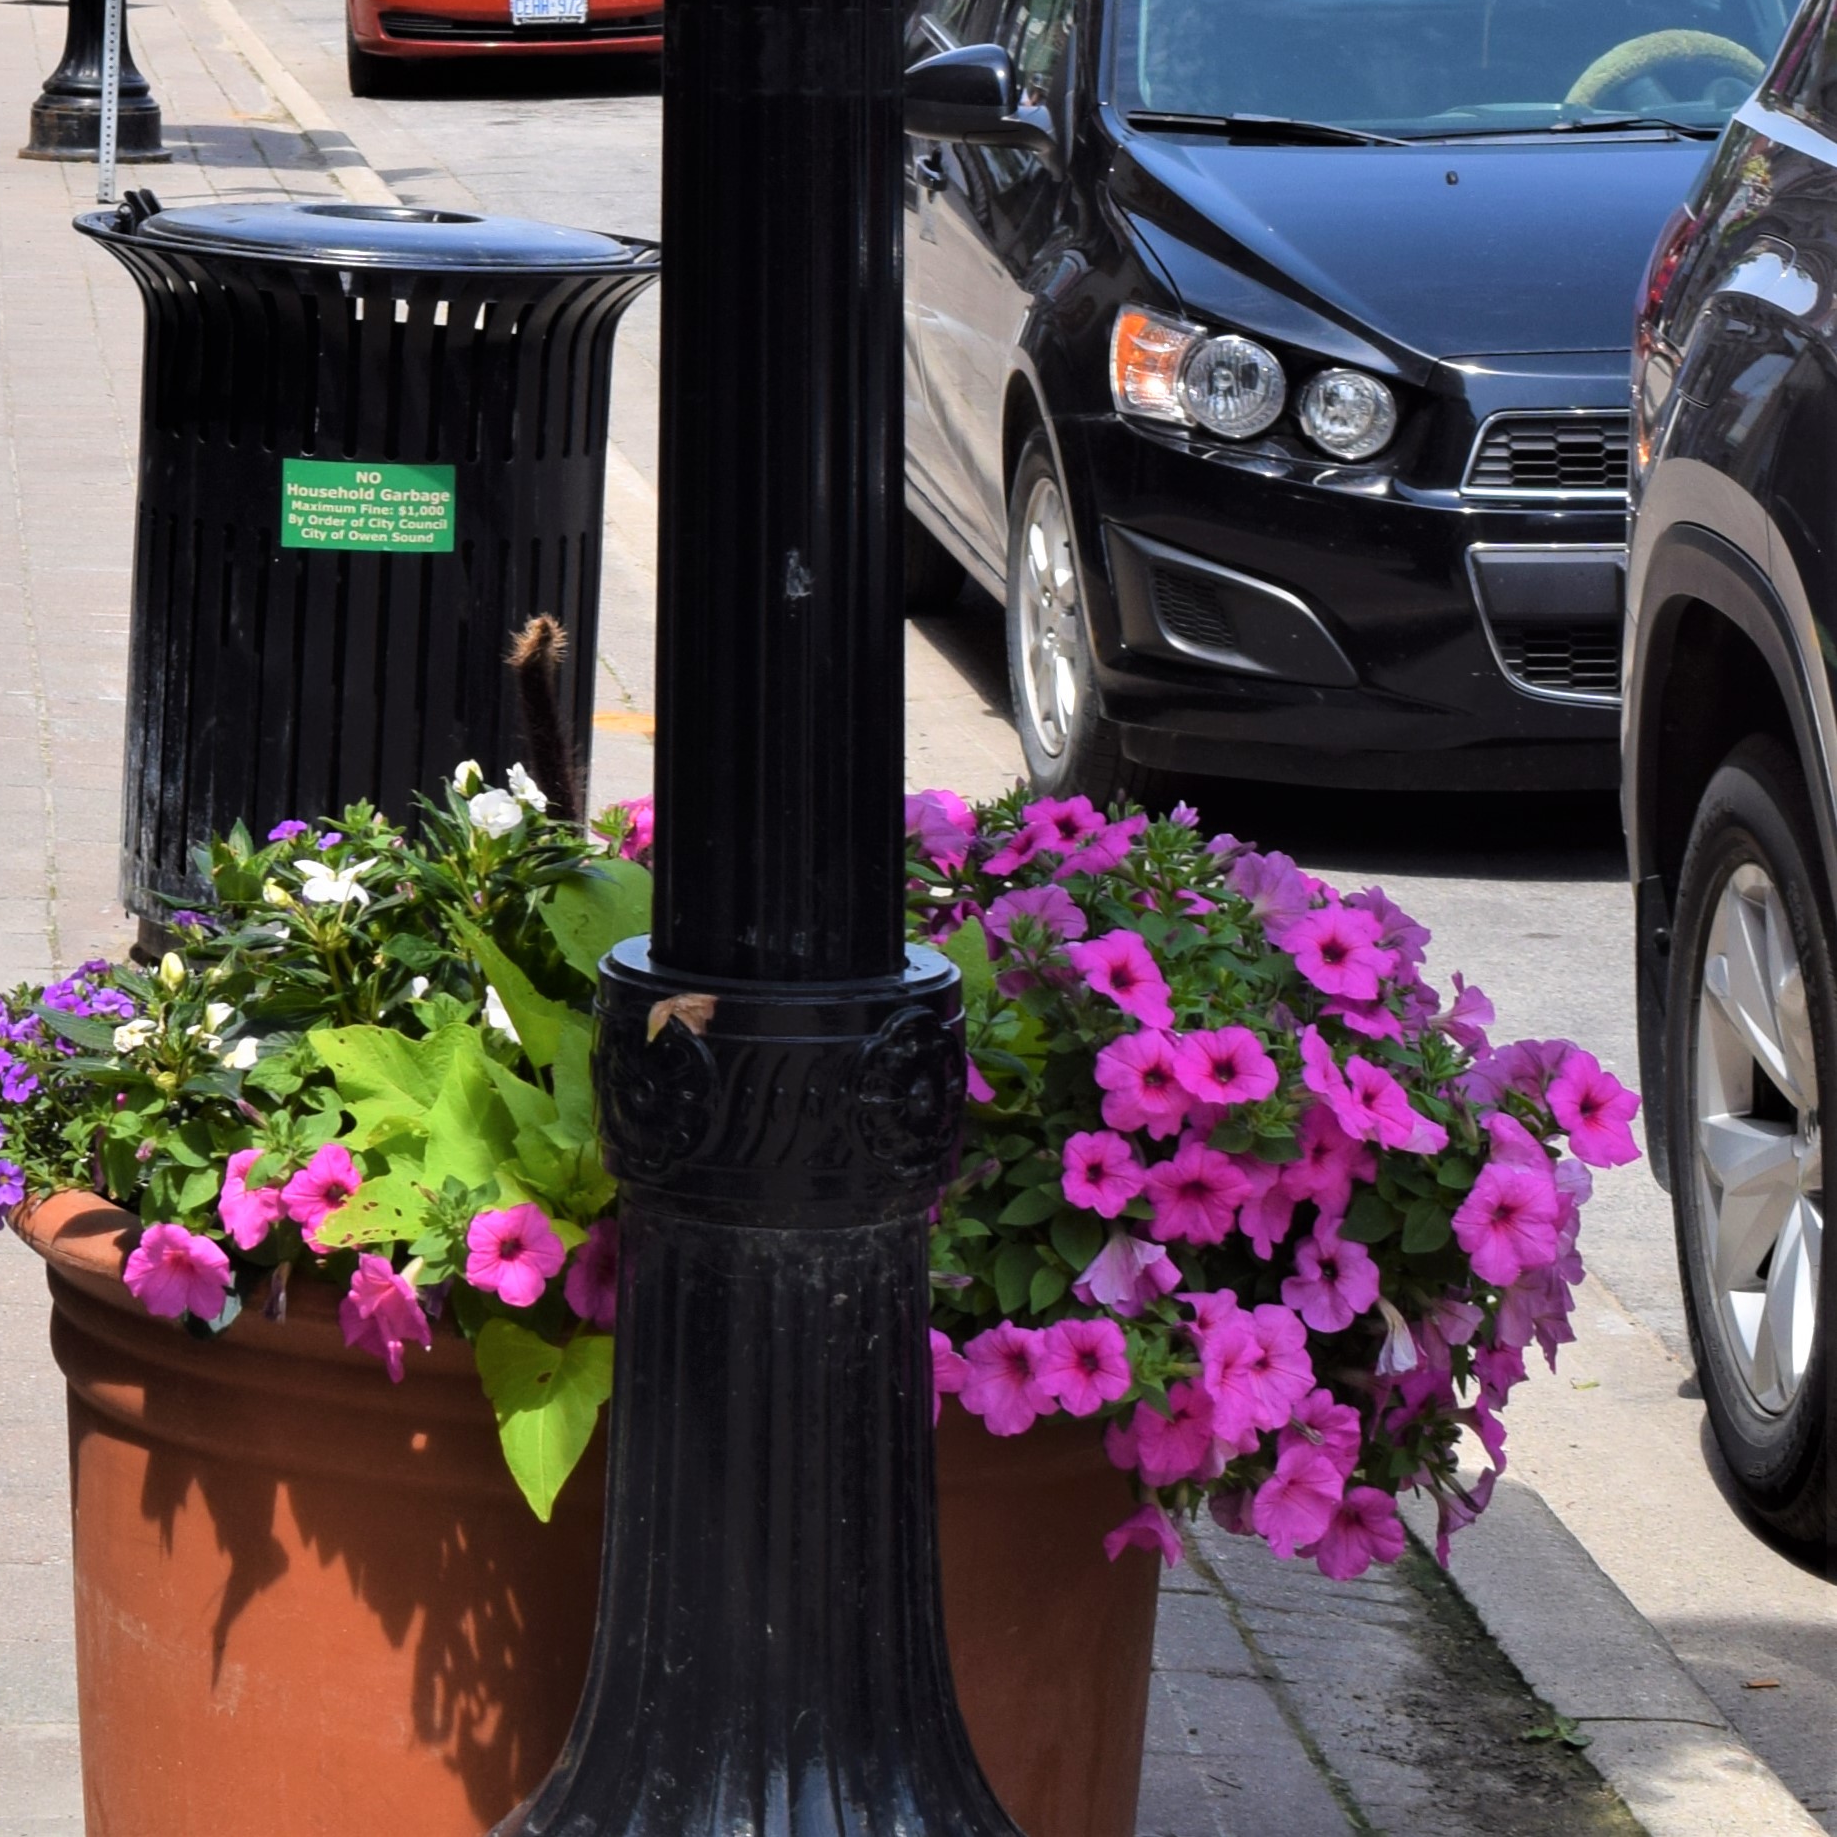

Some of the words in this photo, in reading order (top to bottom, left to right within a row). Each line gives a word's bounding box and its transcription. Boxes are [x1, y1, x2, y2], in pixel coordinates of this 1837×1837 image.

[355, 471, 382, 484] NO
[287, 484, 374, 500] Household
[380, 489, 451, 505] Garbage
[292, 501, 355, 513] Maximum
[360, 505, 393, 515] Fine:
[398, 506, 445, 518] $1,000
[288, 514, 307, 526] By
[308, 515, 346, 527] Order
[351, 517, 364, 528] of
[368, 518, 395, 530] City
[399, 520, 448, 530] Council
[301, 528, 326, 541] City
[331, 530, 344, 540] of
[348, 530, 387, 542] Owen
[392, 532, 434, 543] Sound
